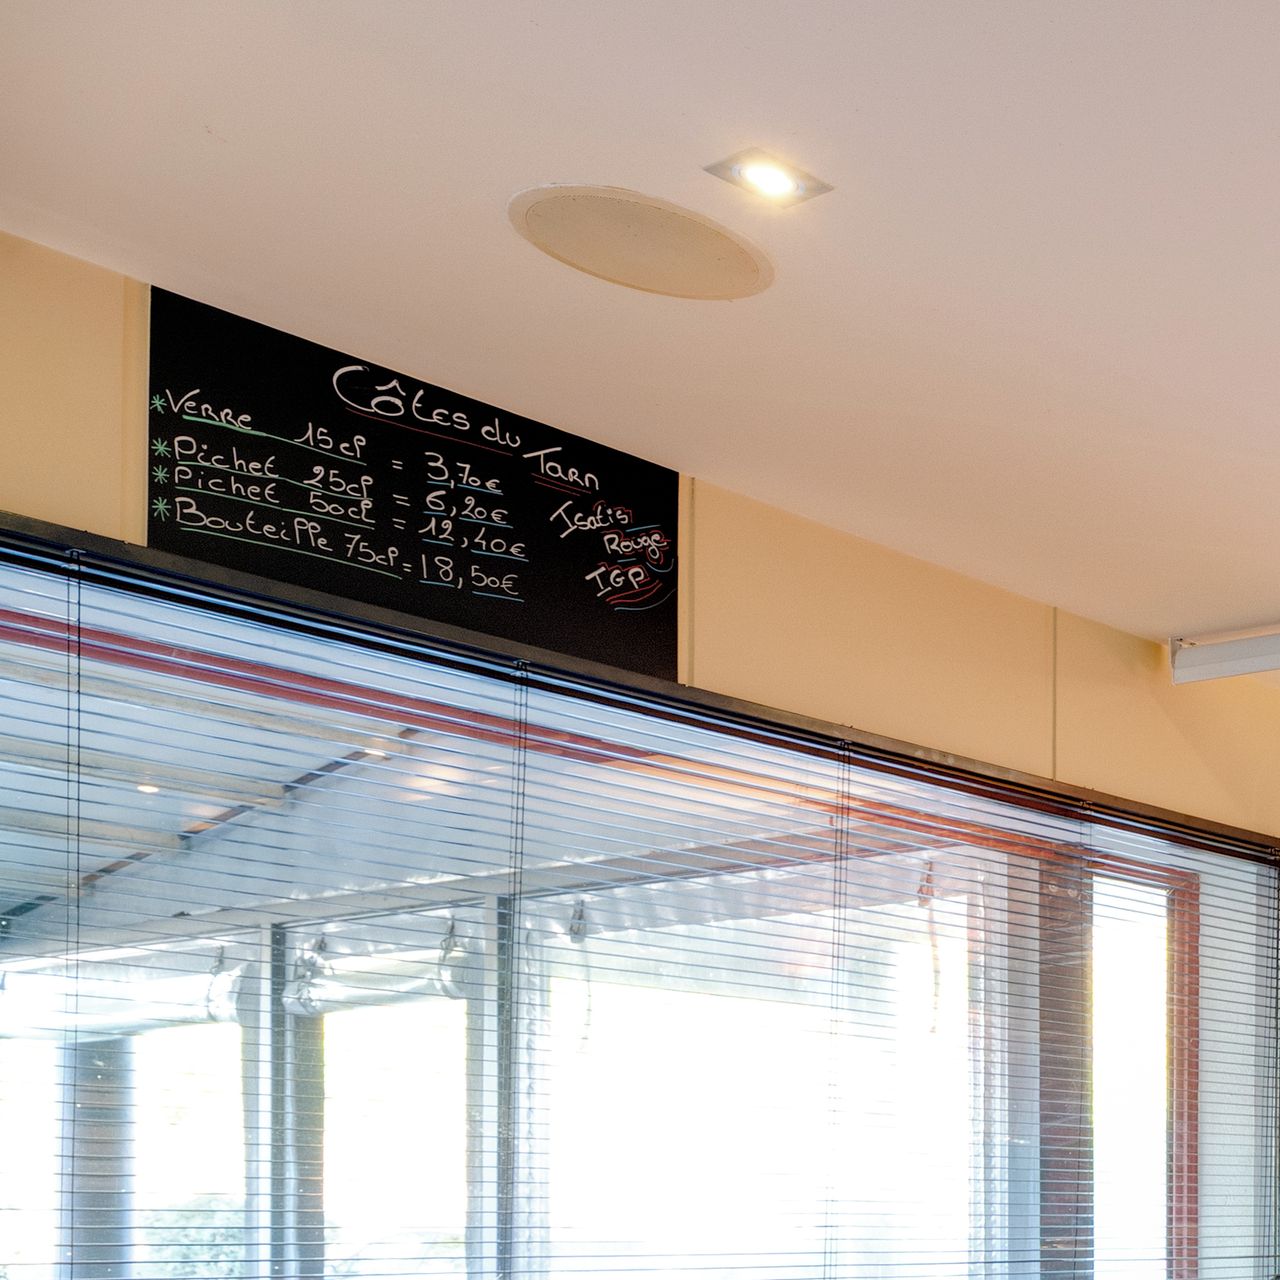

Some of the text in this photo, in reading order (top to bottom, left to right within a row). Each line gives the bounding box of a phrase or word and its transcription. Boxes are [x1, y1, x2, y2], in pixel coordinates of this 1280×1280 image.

[333, 366, 599, 490] Côtes du Tarn
[424, 452, 502, 492] 3,70€
[174, 436, 280, 478] Pichet
[303, 465, 373, 500] 25cl
[425, 490, 508, 524] 6,20€
[175, 466, 280, 503] Pichet
[309, 491, 376, 524] 50cl
[418, 516, 526, 558] 12,40€
[175, 497, 333, 552] Bouteille
[344, 533, 399, 567] 75cl
[420, 553, 518, 595] 18,50€
[585, 566, 645, 597] IGP
[604, 532, 668, 559] Rouge
